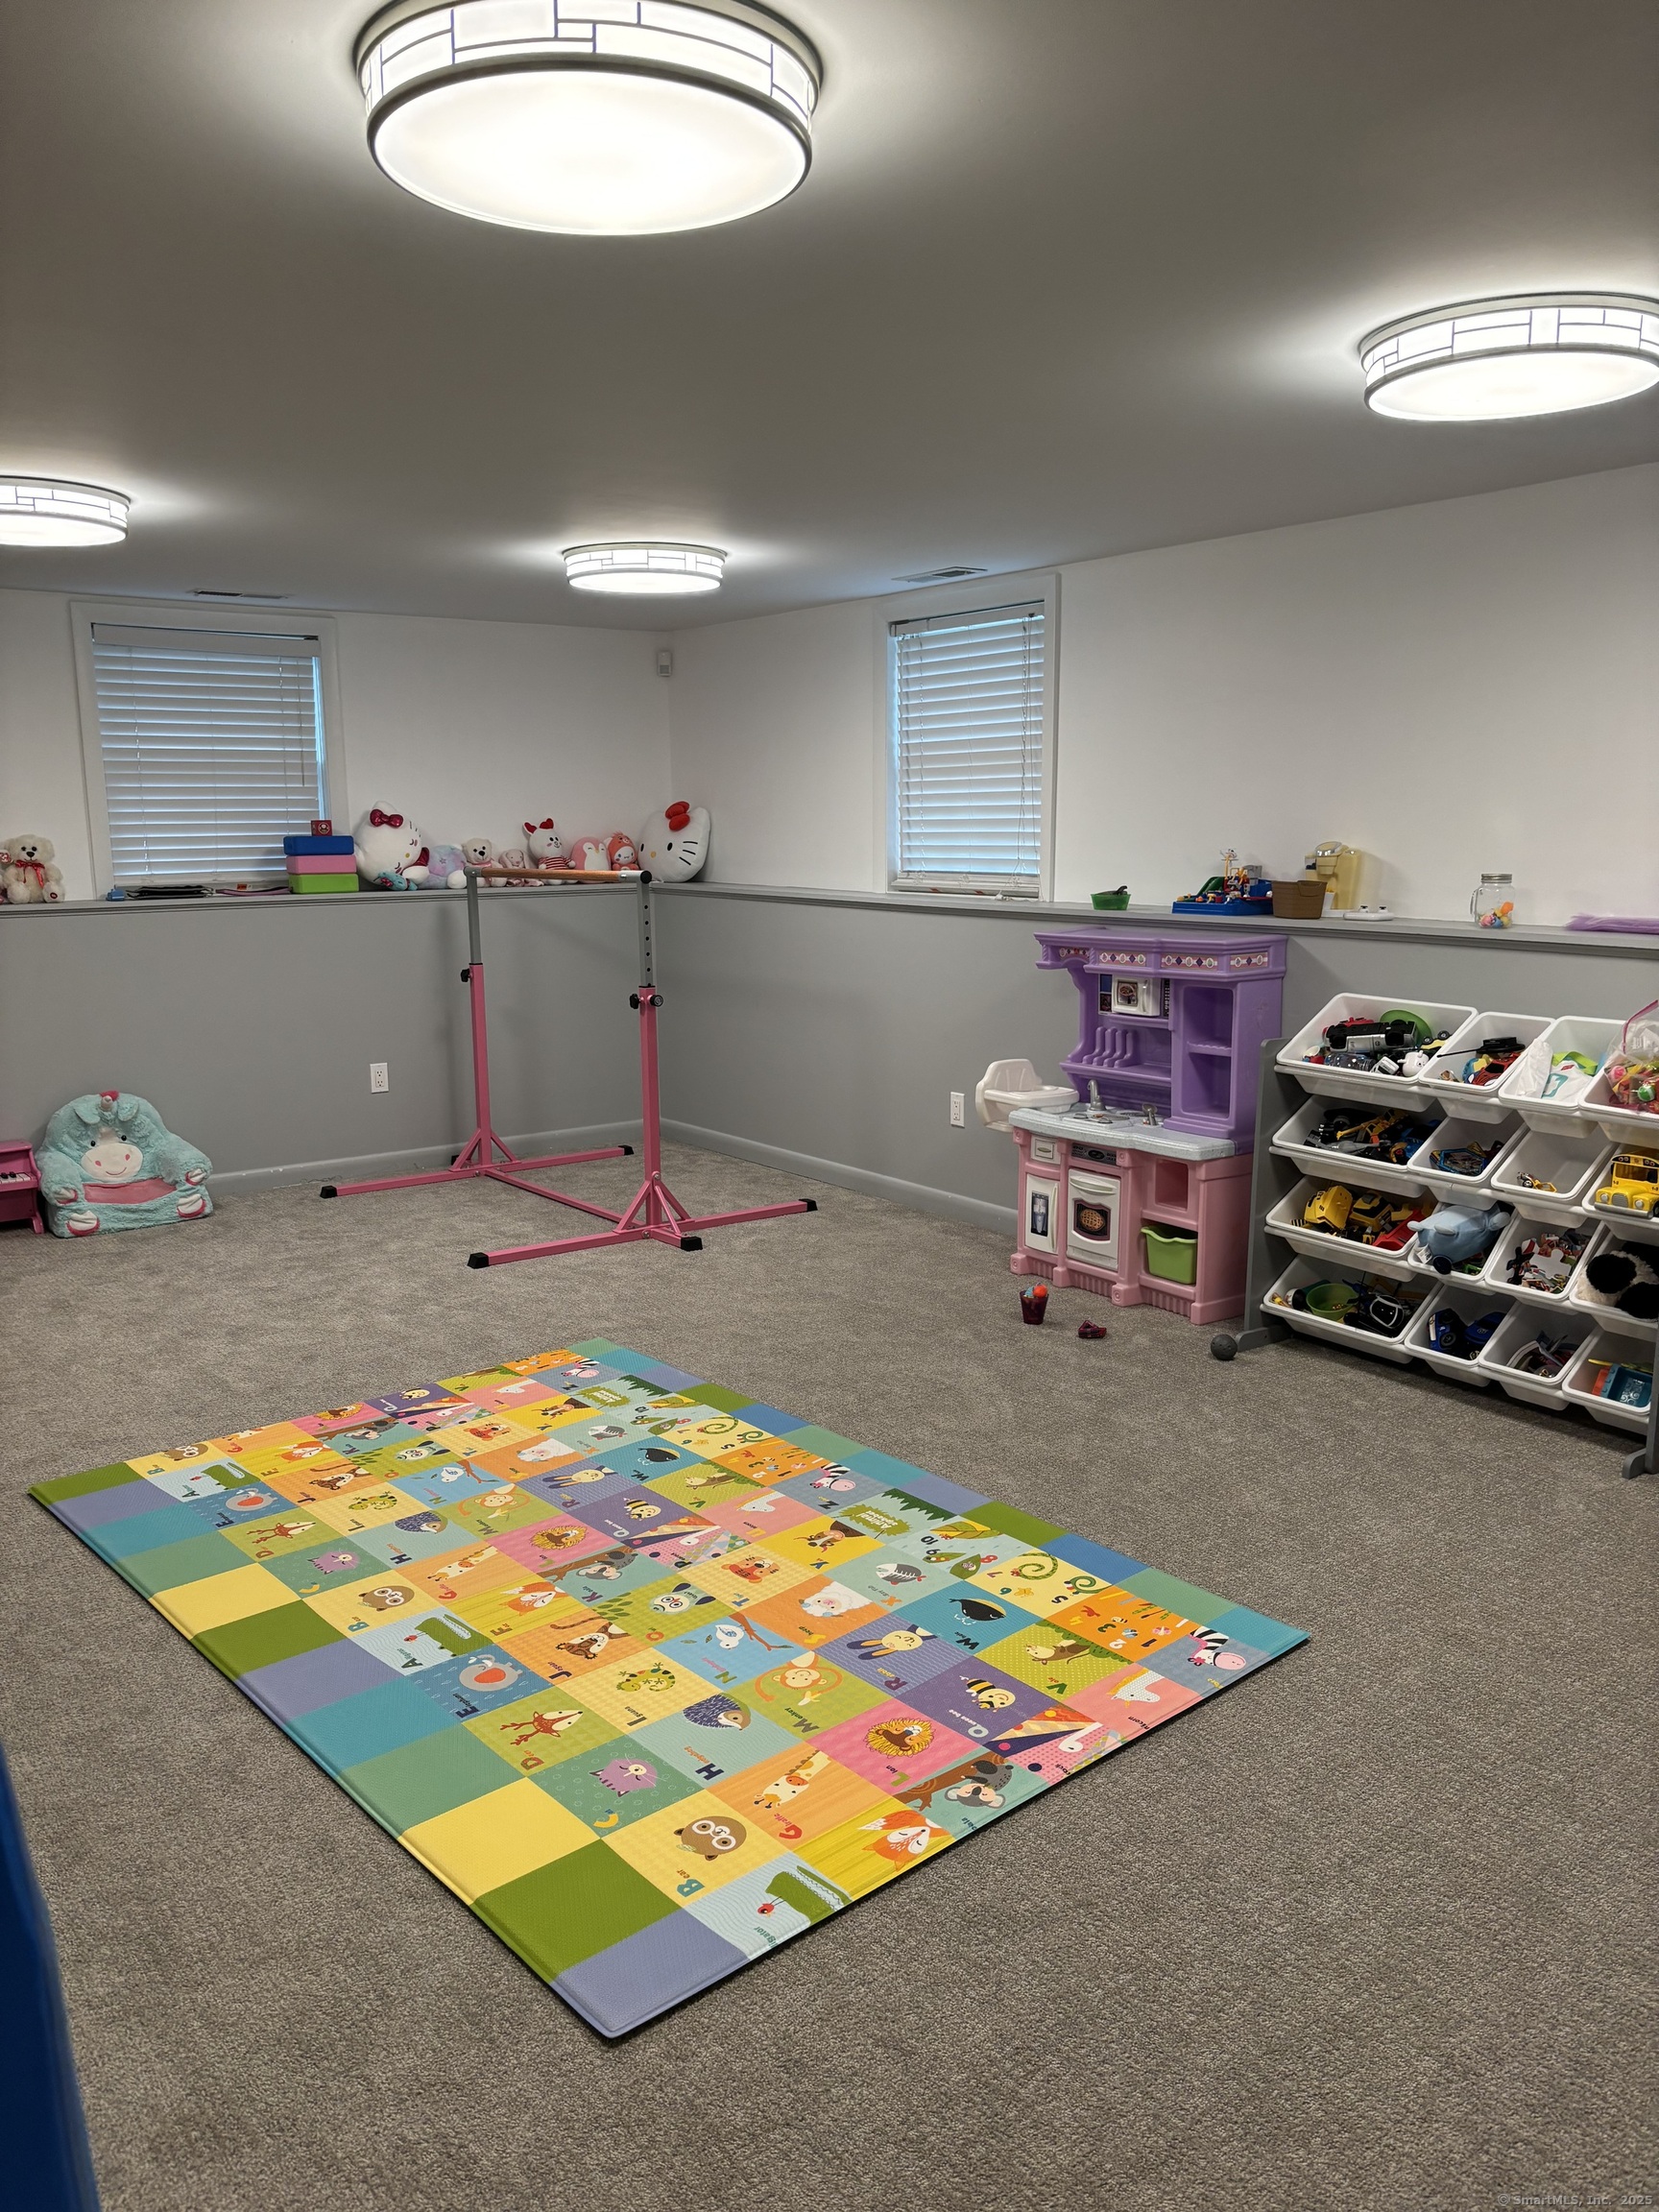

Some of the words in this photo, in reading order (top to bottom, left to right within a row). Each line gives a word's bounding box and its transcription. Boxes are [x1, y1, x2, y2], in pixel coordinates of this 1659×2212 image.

[921, 1535, 939, 1545] 10
[980, 1554, 998, 1563] 8
[1051, 1596, 1069, 1604] 5
[1070, 1616, 1083, 1625] 4
[1097, 1623, 1117, 1633] 3
[1109, 1639, 1127, 1649] 2
[1141, 1638, 1158, 1647] 1
[624, 1706, 647, 1726] Iguana
[784, 1707, 820, 1733] Monkey
[1128, 1716, 1150, 1731] nicorn
[961, 1715, 990, 1739] Queen
[885, 1765, 911, 1788] Lion
[774, 1813, 803, 1839] Giraffe
[961, 1816, 978, 1831] oala
[676, 1867, 706, 1898] Bear
